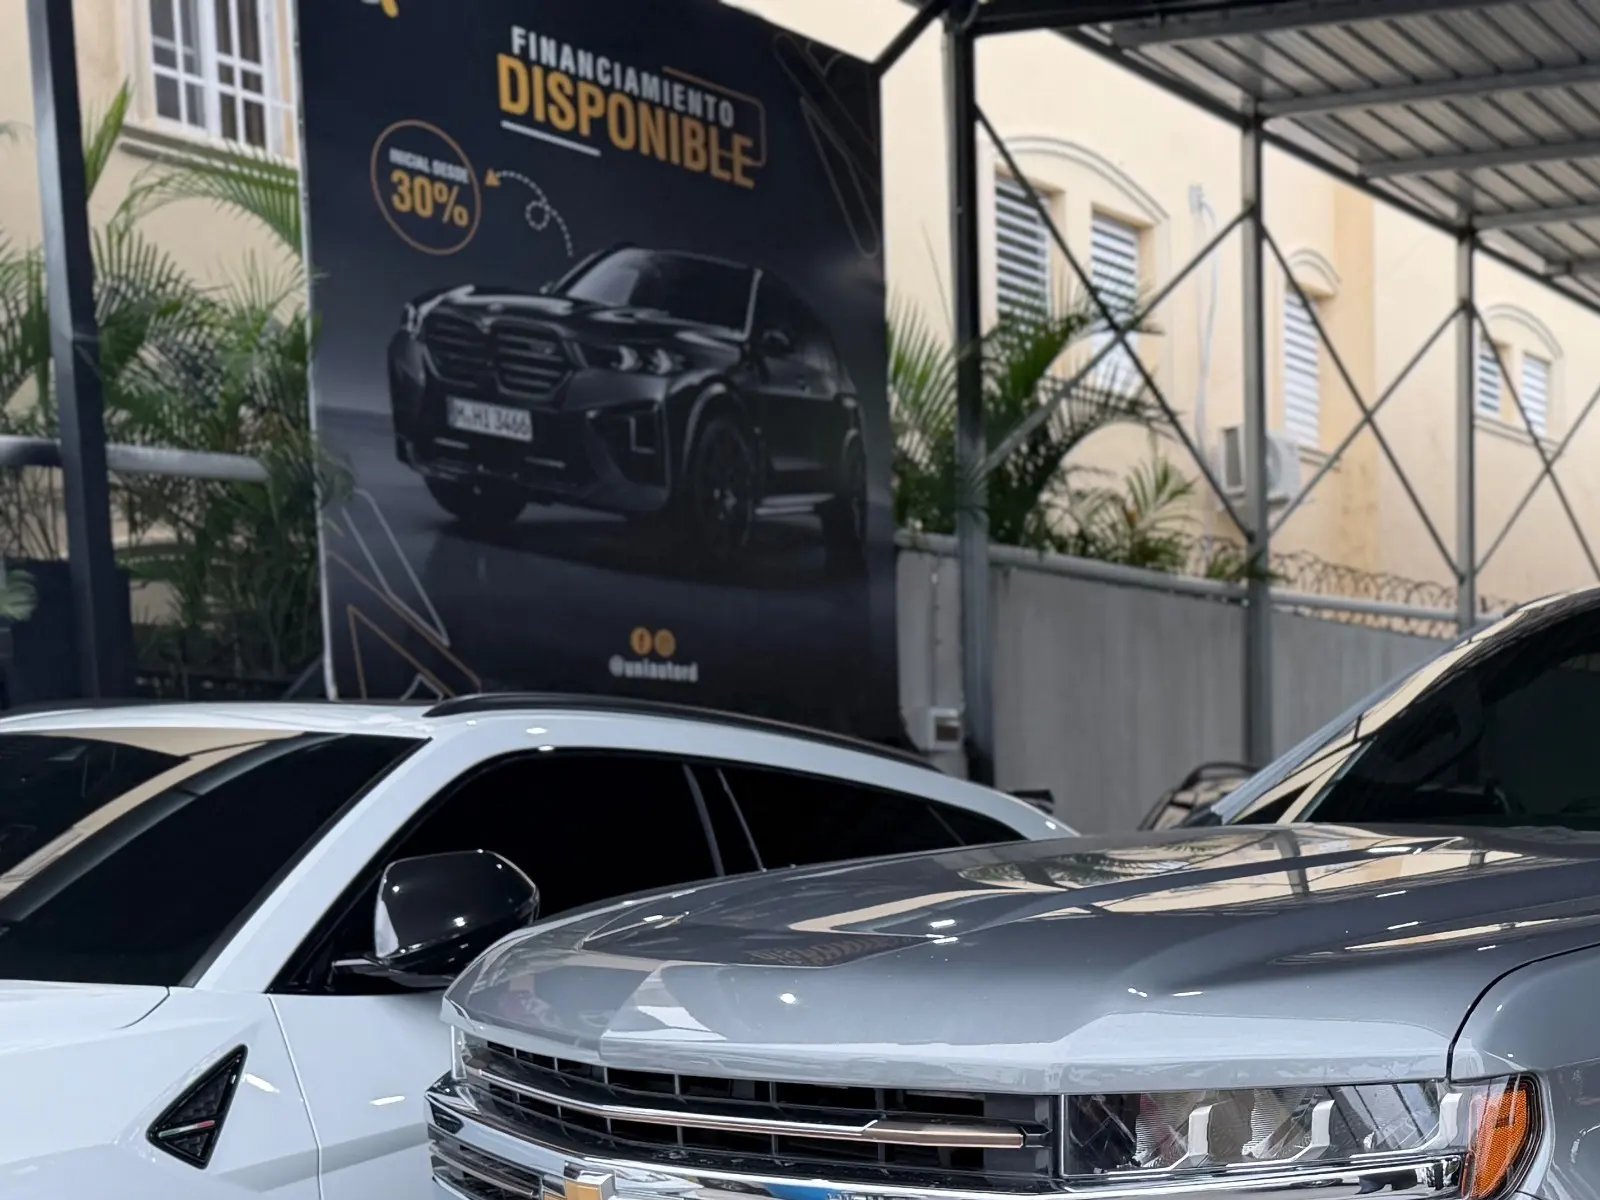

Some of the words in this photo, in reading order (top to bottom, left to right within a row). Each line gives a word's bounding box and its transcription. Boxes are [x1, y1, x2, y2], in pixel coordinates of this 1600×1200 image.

[497, 53, 756, 189] DISPONIBLE
[510, 25, 735, 129] FINANCIAMIENTO
[390, 168, 470, 228] 30%
